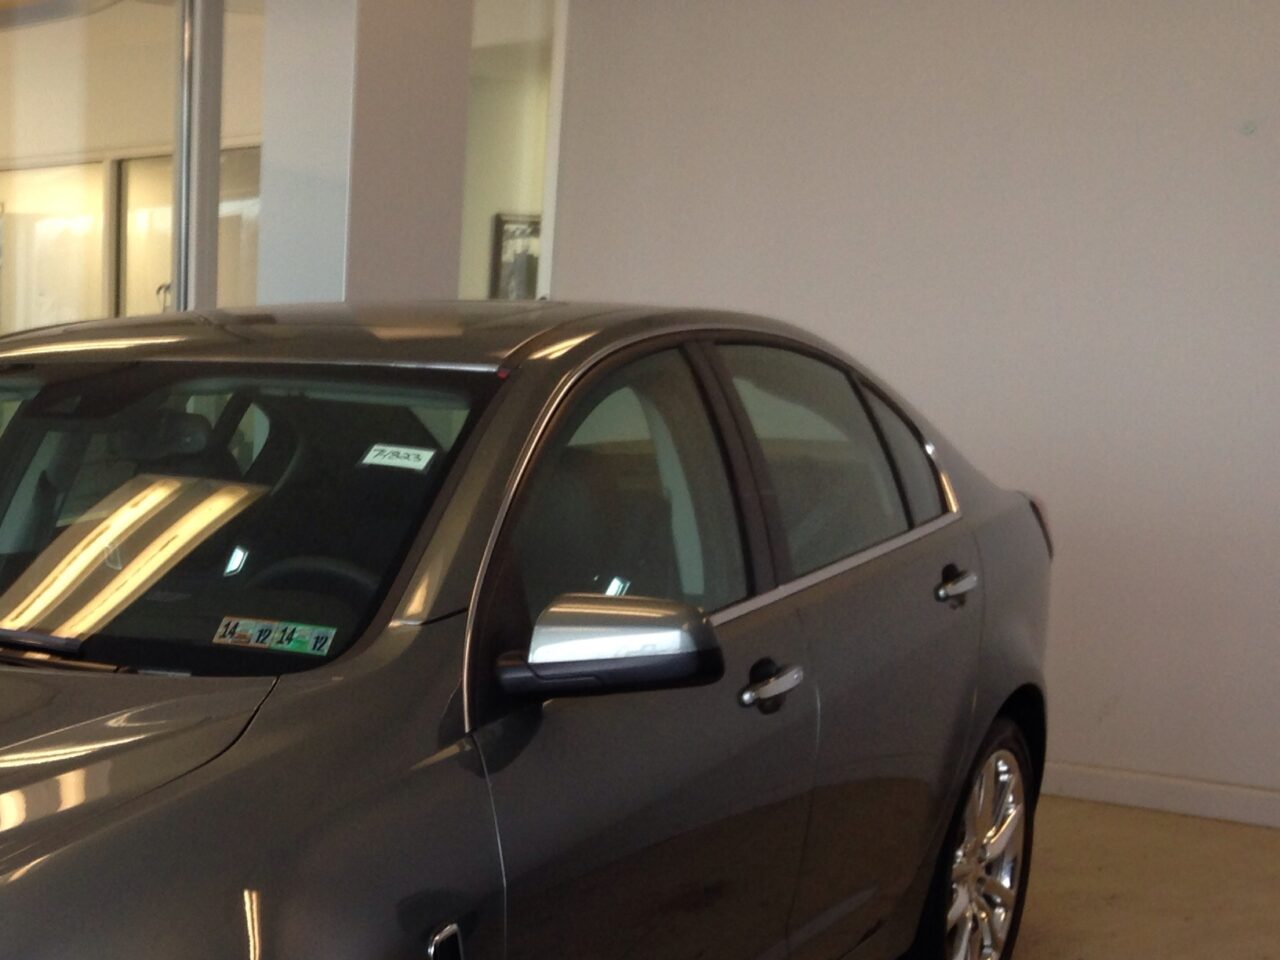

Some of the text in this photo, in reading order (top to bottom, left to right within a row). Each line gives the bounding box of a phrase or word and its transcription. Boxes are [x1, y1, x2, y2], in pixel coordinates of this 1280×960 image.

[220, 620, 272, 644] 14 12
[277, 626, 329, 652] 14 12
